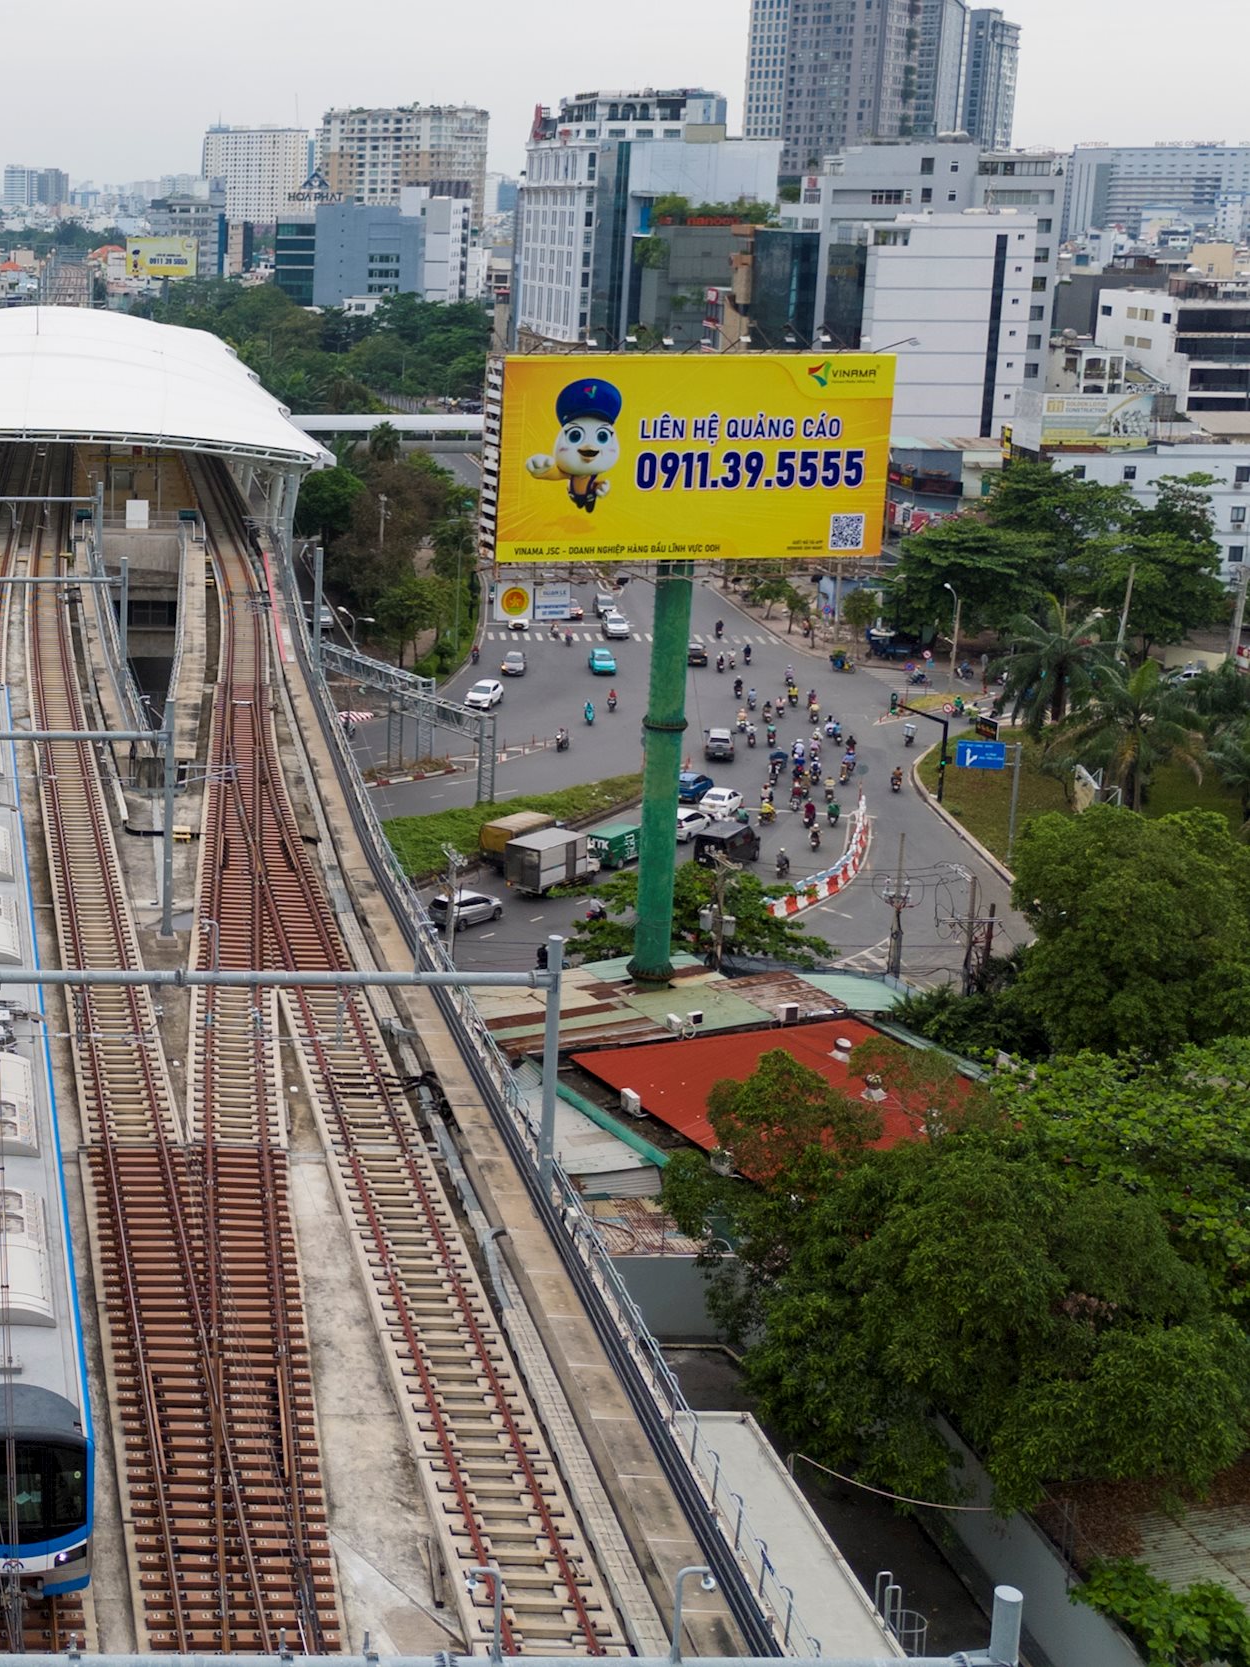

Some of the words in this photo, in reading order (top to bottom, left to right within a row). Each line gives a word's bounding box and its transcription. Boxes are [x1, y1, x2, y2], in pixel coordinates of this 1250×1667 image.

[832, 368, 877, 378] VINAMA
[639, 413, 686, 440] LIÊN
[693, 413, 720, 445] HỆ
[726, 412, 795, 440] QUẢNG
[802, 412, 841, 438] CÁO
[636, 449, 866, 490] 0911.39.5555
[514, 547, 544, 556] VINAMA
[546, 547, 560, 556] JSC
[568, 546, 595, 555] DOANH
[597, 544, 626, 556] NGHIỆP
[627, 543, 649, 553] HÀNG
[650, 541, 667, 553] ĐẦU
[668, 542, 686, 553] LĨNH
[687, 544, 703, 556] VỰC
[705, 544, 720, 553] OOH
